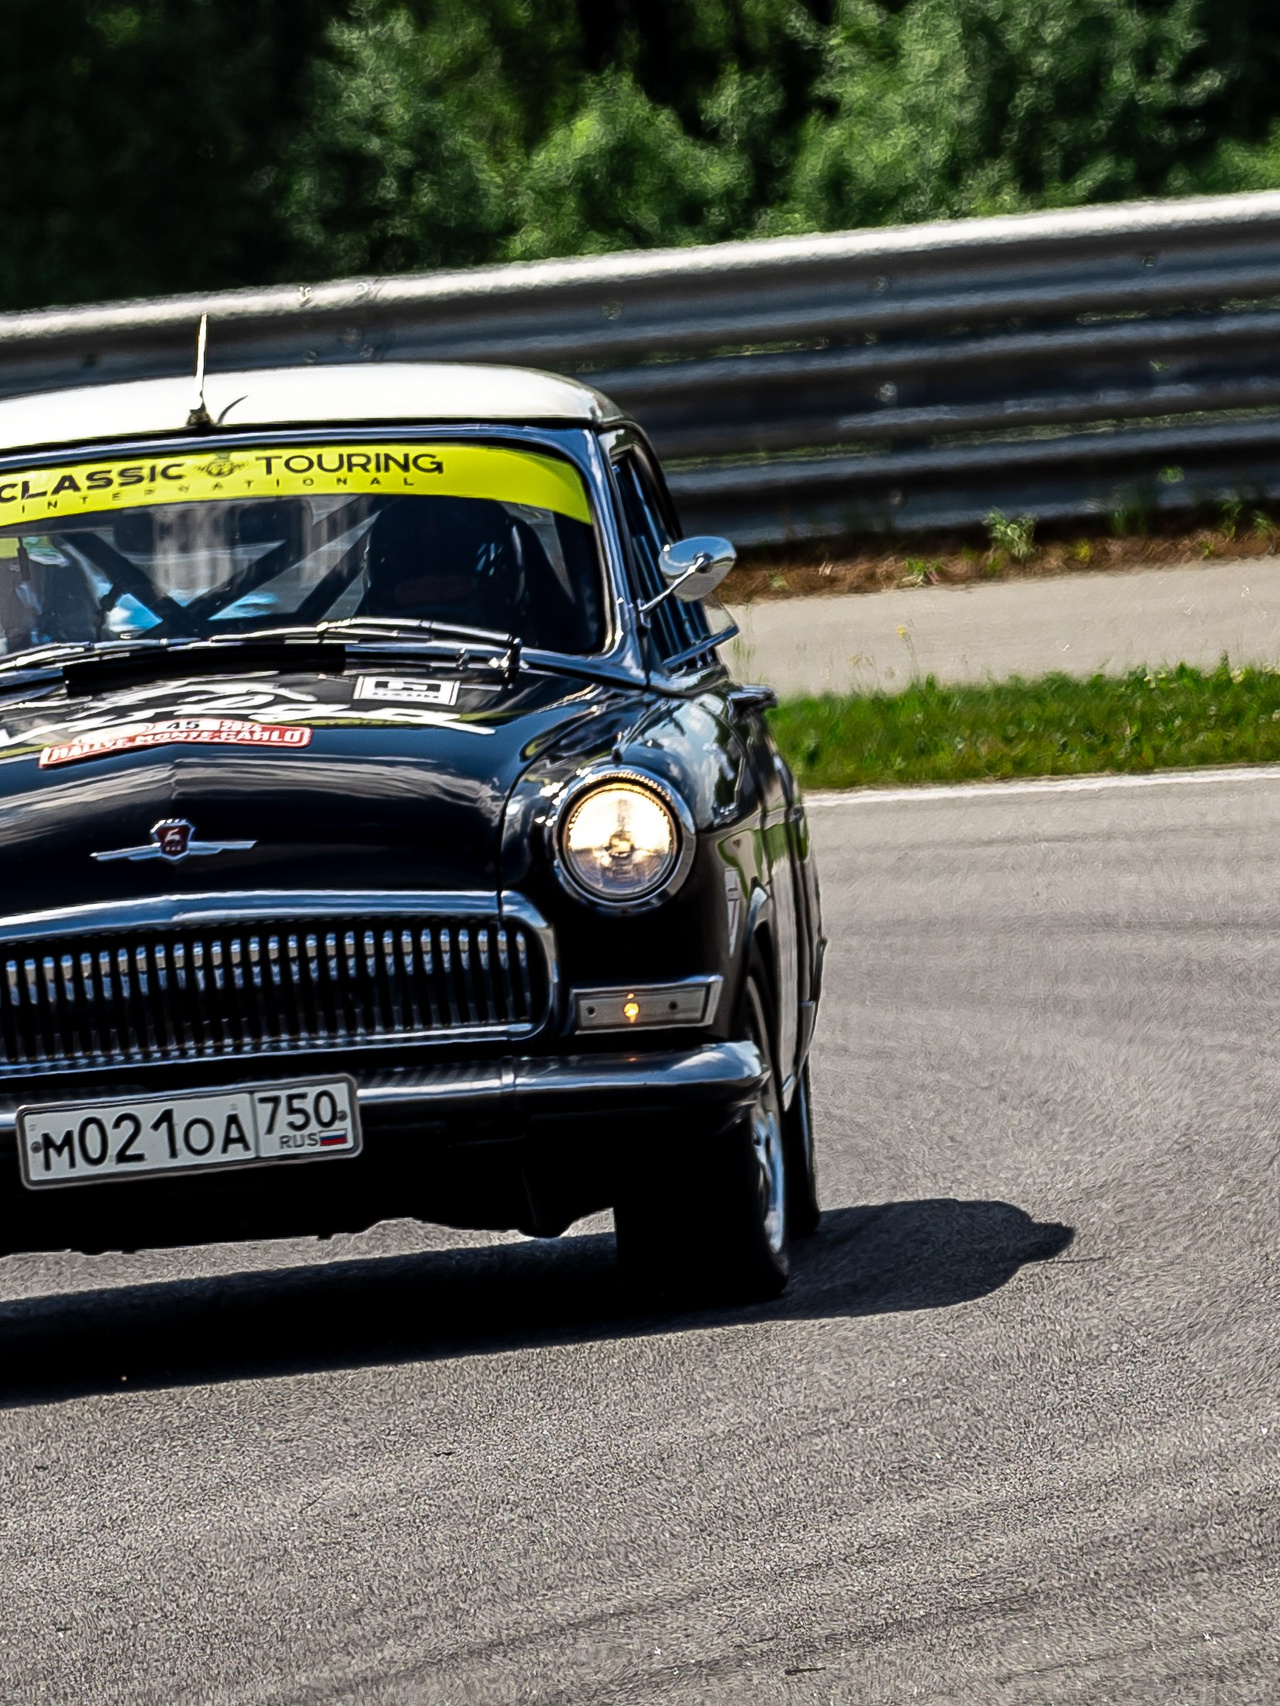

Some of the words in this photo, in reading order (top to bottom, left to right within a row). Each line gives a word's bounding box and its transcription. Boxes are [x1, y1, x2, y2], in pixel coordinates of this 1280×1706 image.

[255, 452, 444, 475] TOURING
[21, 477, 416, 514] INTERNATIONAL
[166, 719, 202, 731] 45
[257, 1089, 339, 1136] 750
[279, 1132, 320, 1150] RUS
